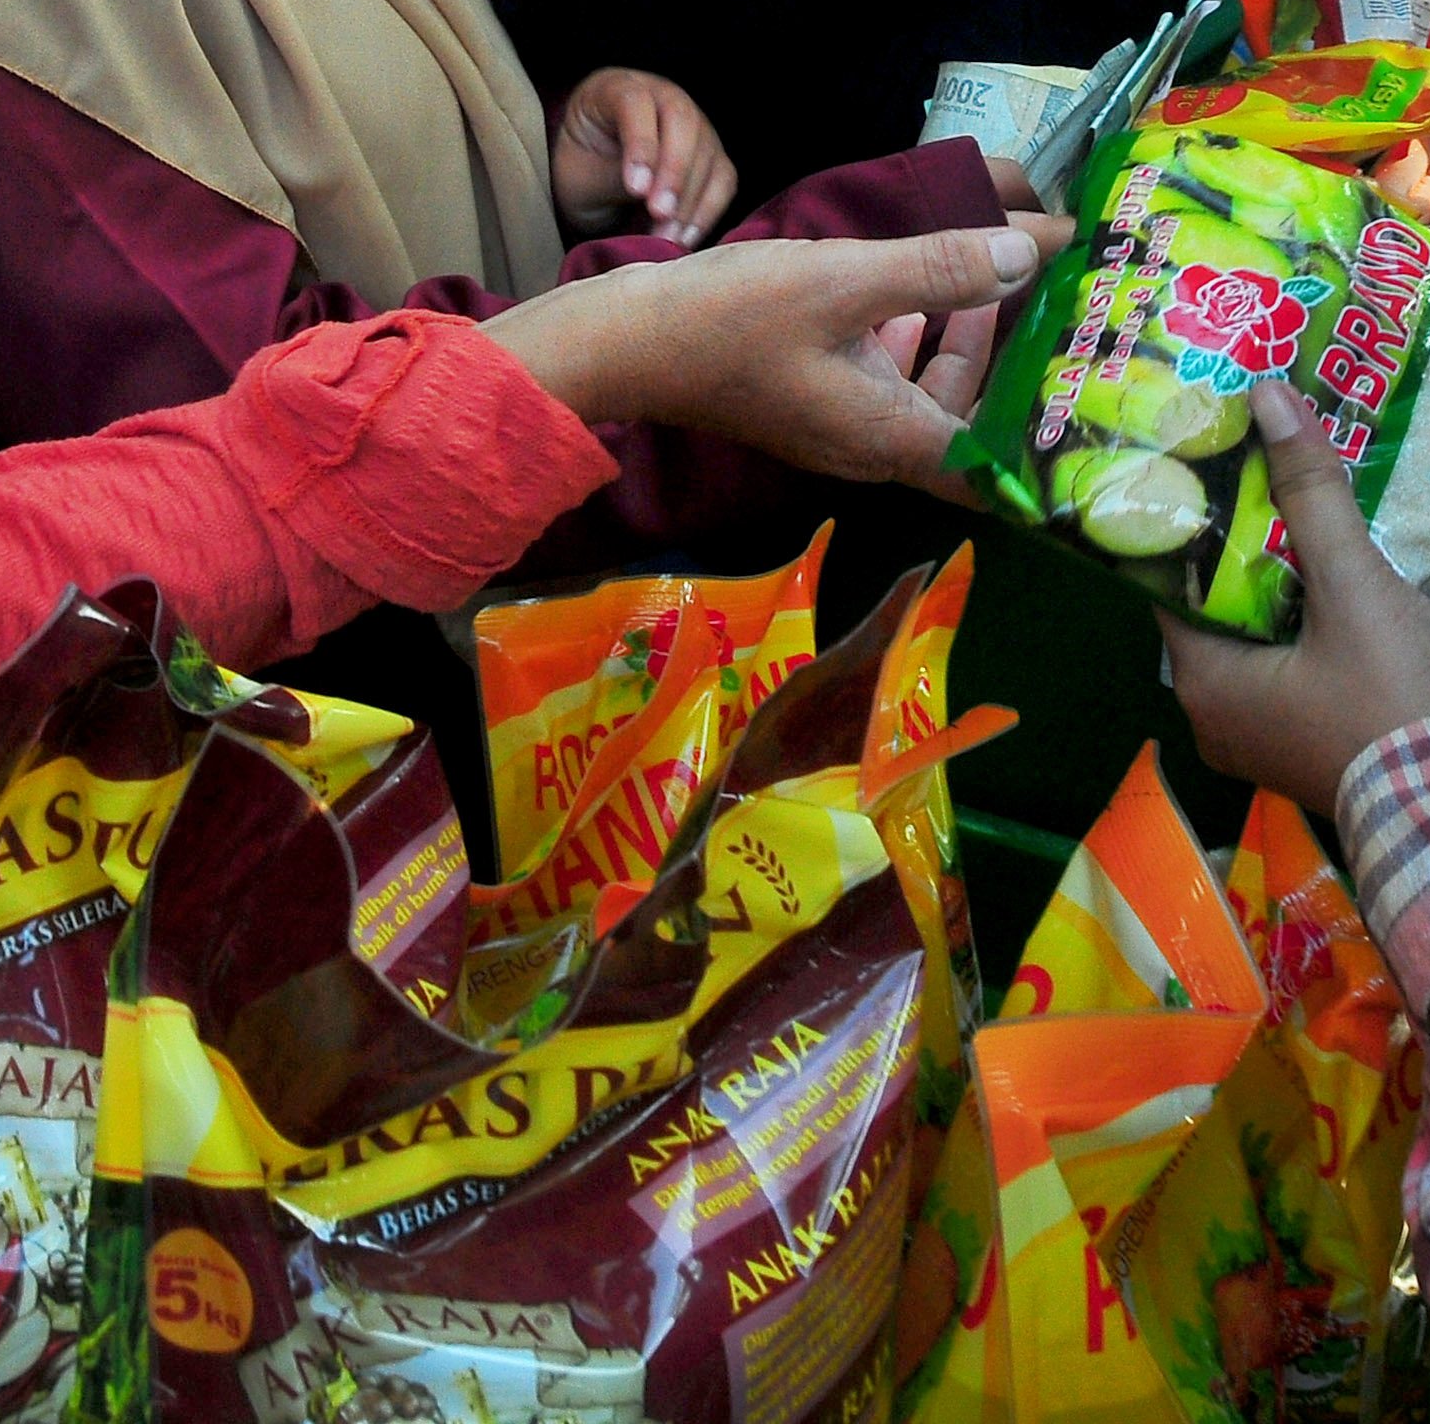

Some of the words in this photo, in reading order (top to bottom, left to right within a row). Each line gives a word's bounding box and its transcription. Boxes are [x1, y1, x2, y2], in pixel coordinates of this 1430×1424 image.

[1035, 363, 1091, 452] GULA
[1066, 234, 1136, 359] KRISTAL
[1098, 307, 1147, 384] Manis
[52, 891, 128, 939] SELERA
[359, 920, 397, 962] baik
[720, 1020, 828, 1113] RAJA
[377, 1187, 461, 1241] BERAS
[726, 1212, 837, 1315] ANAK
